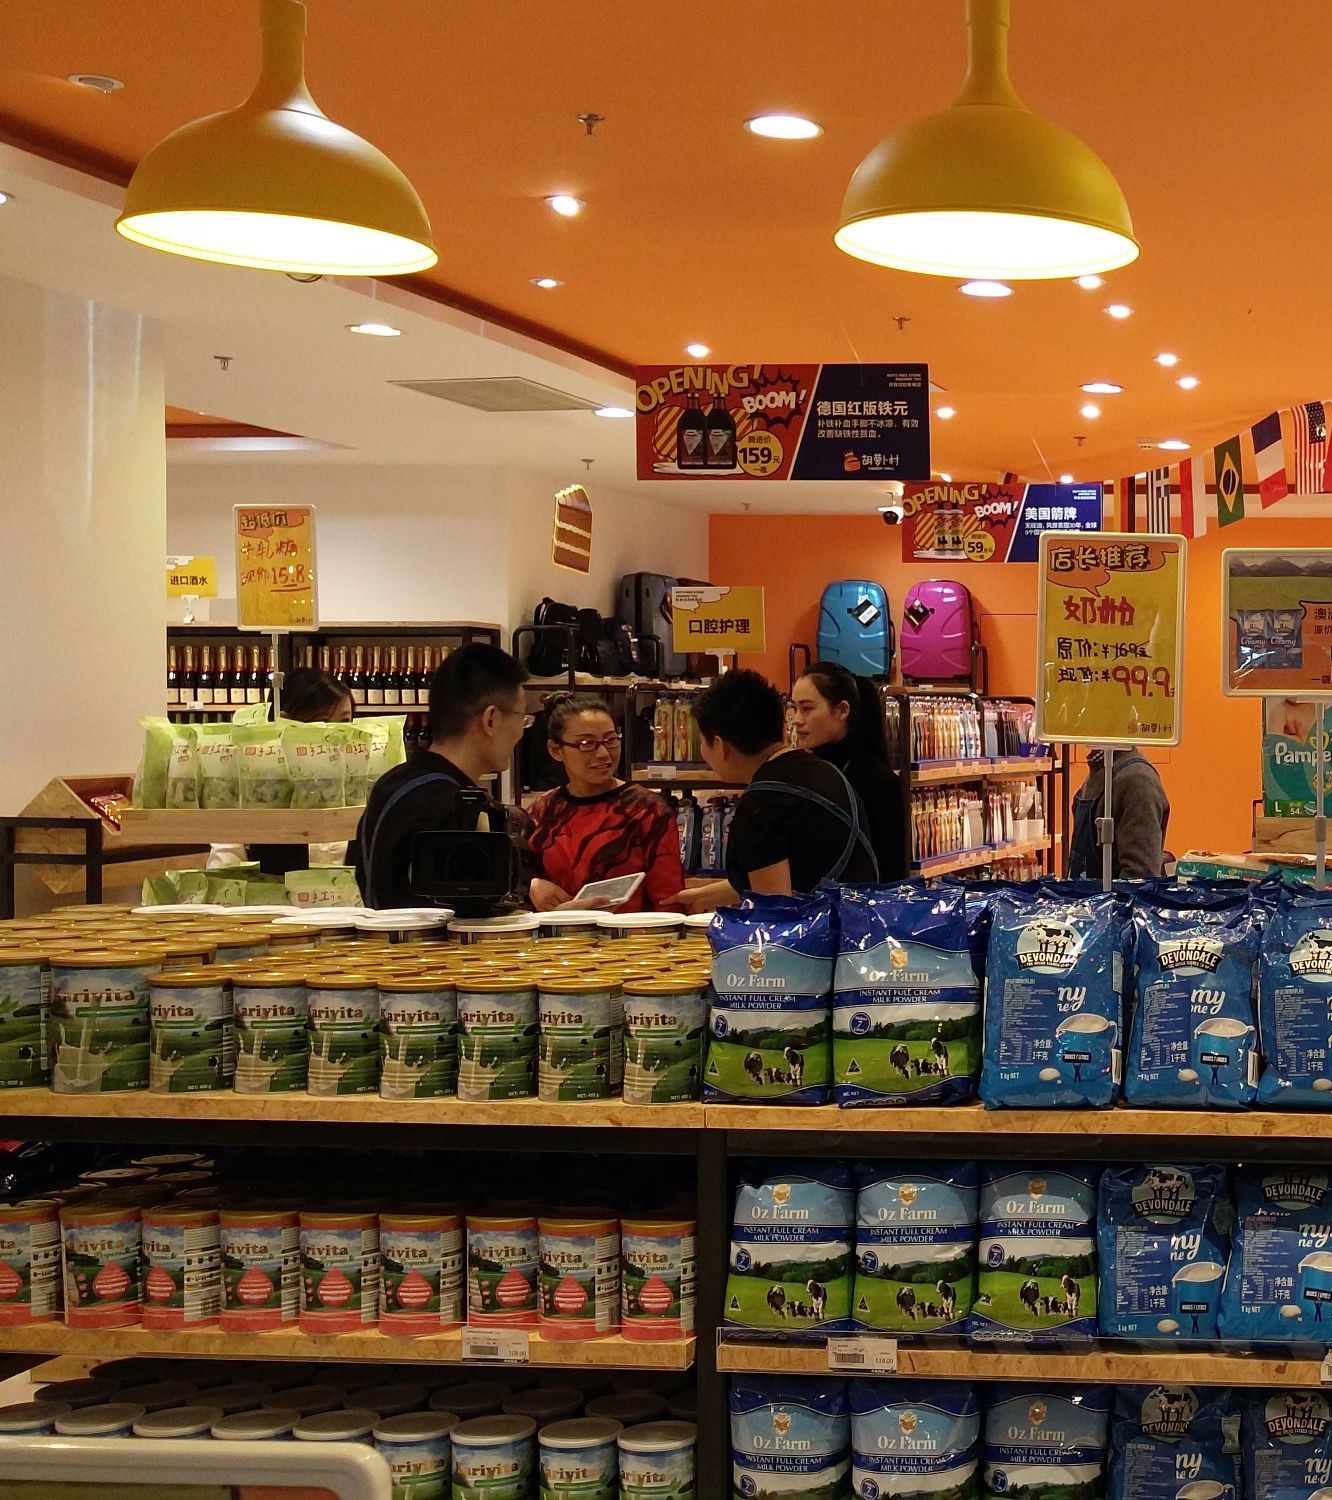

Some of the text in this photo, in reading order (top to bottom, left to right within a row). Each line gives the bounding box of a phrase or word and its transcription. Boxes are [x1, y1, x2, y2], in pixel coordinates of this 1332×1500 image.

[636, 364, 762, 412] OPENING!
[742, 389, 807, 413] BOOM!
[817, 400, 908, 416] 德国红版铁元
[902, 483, 988, 516] OPENING!
[974, 500, 1019, 518] BOOM!
[1050, 545, 1149, 573] 店长推荐
[169, 574, 209, 587] 进口酒水
[688, 618, 751, 634] 口腔护理
[1161, 950, 1218, 967] DEVONDALE
[726, 974, 785, 988] Oz Farm
[869, 970, 929, 983] Oz Farm
[1265, 1183, 1324, 1202] DEVONDALE
[751, 1205, 809, 1220] Oz Farm
[1006, 1200, 1066, 1215] Oz Farm
[1135, 1198, 1192, 1213] DEVONDALE
[878, 1207, 937, 1221] Oz Farm
[1142, 1421, 1188, 1434] DEVOND
[1268, 1418, 1326, 1435] DEVONDALE
[753, 1436, 811, 1450] Oz Farm
[877, 1436, 936, 1450] Oz Farm
